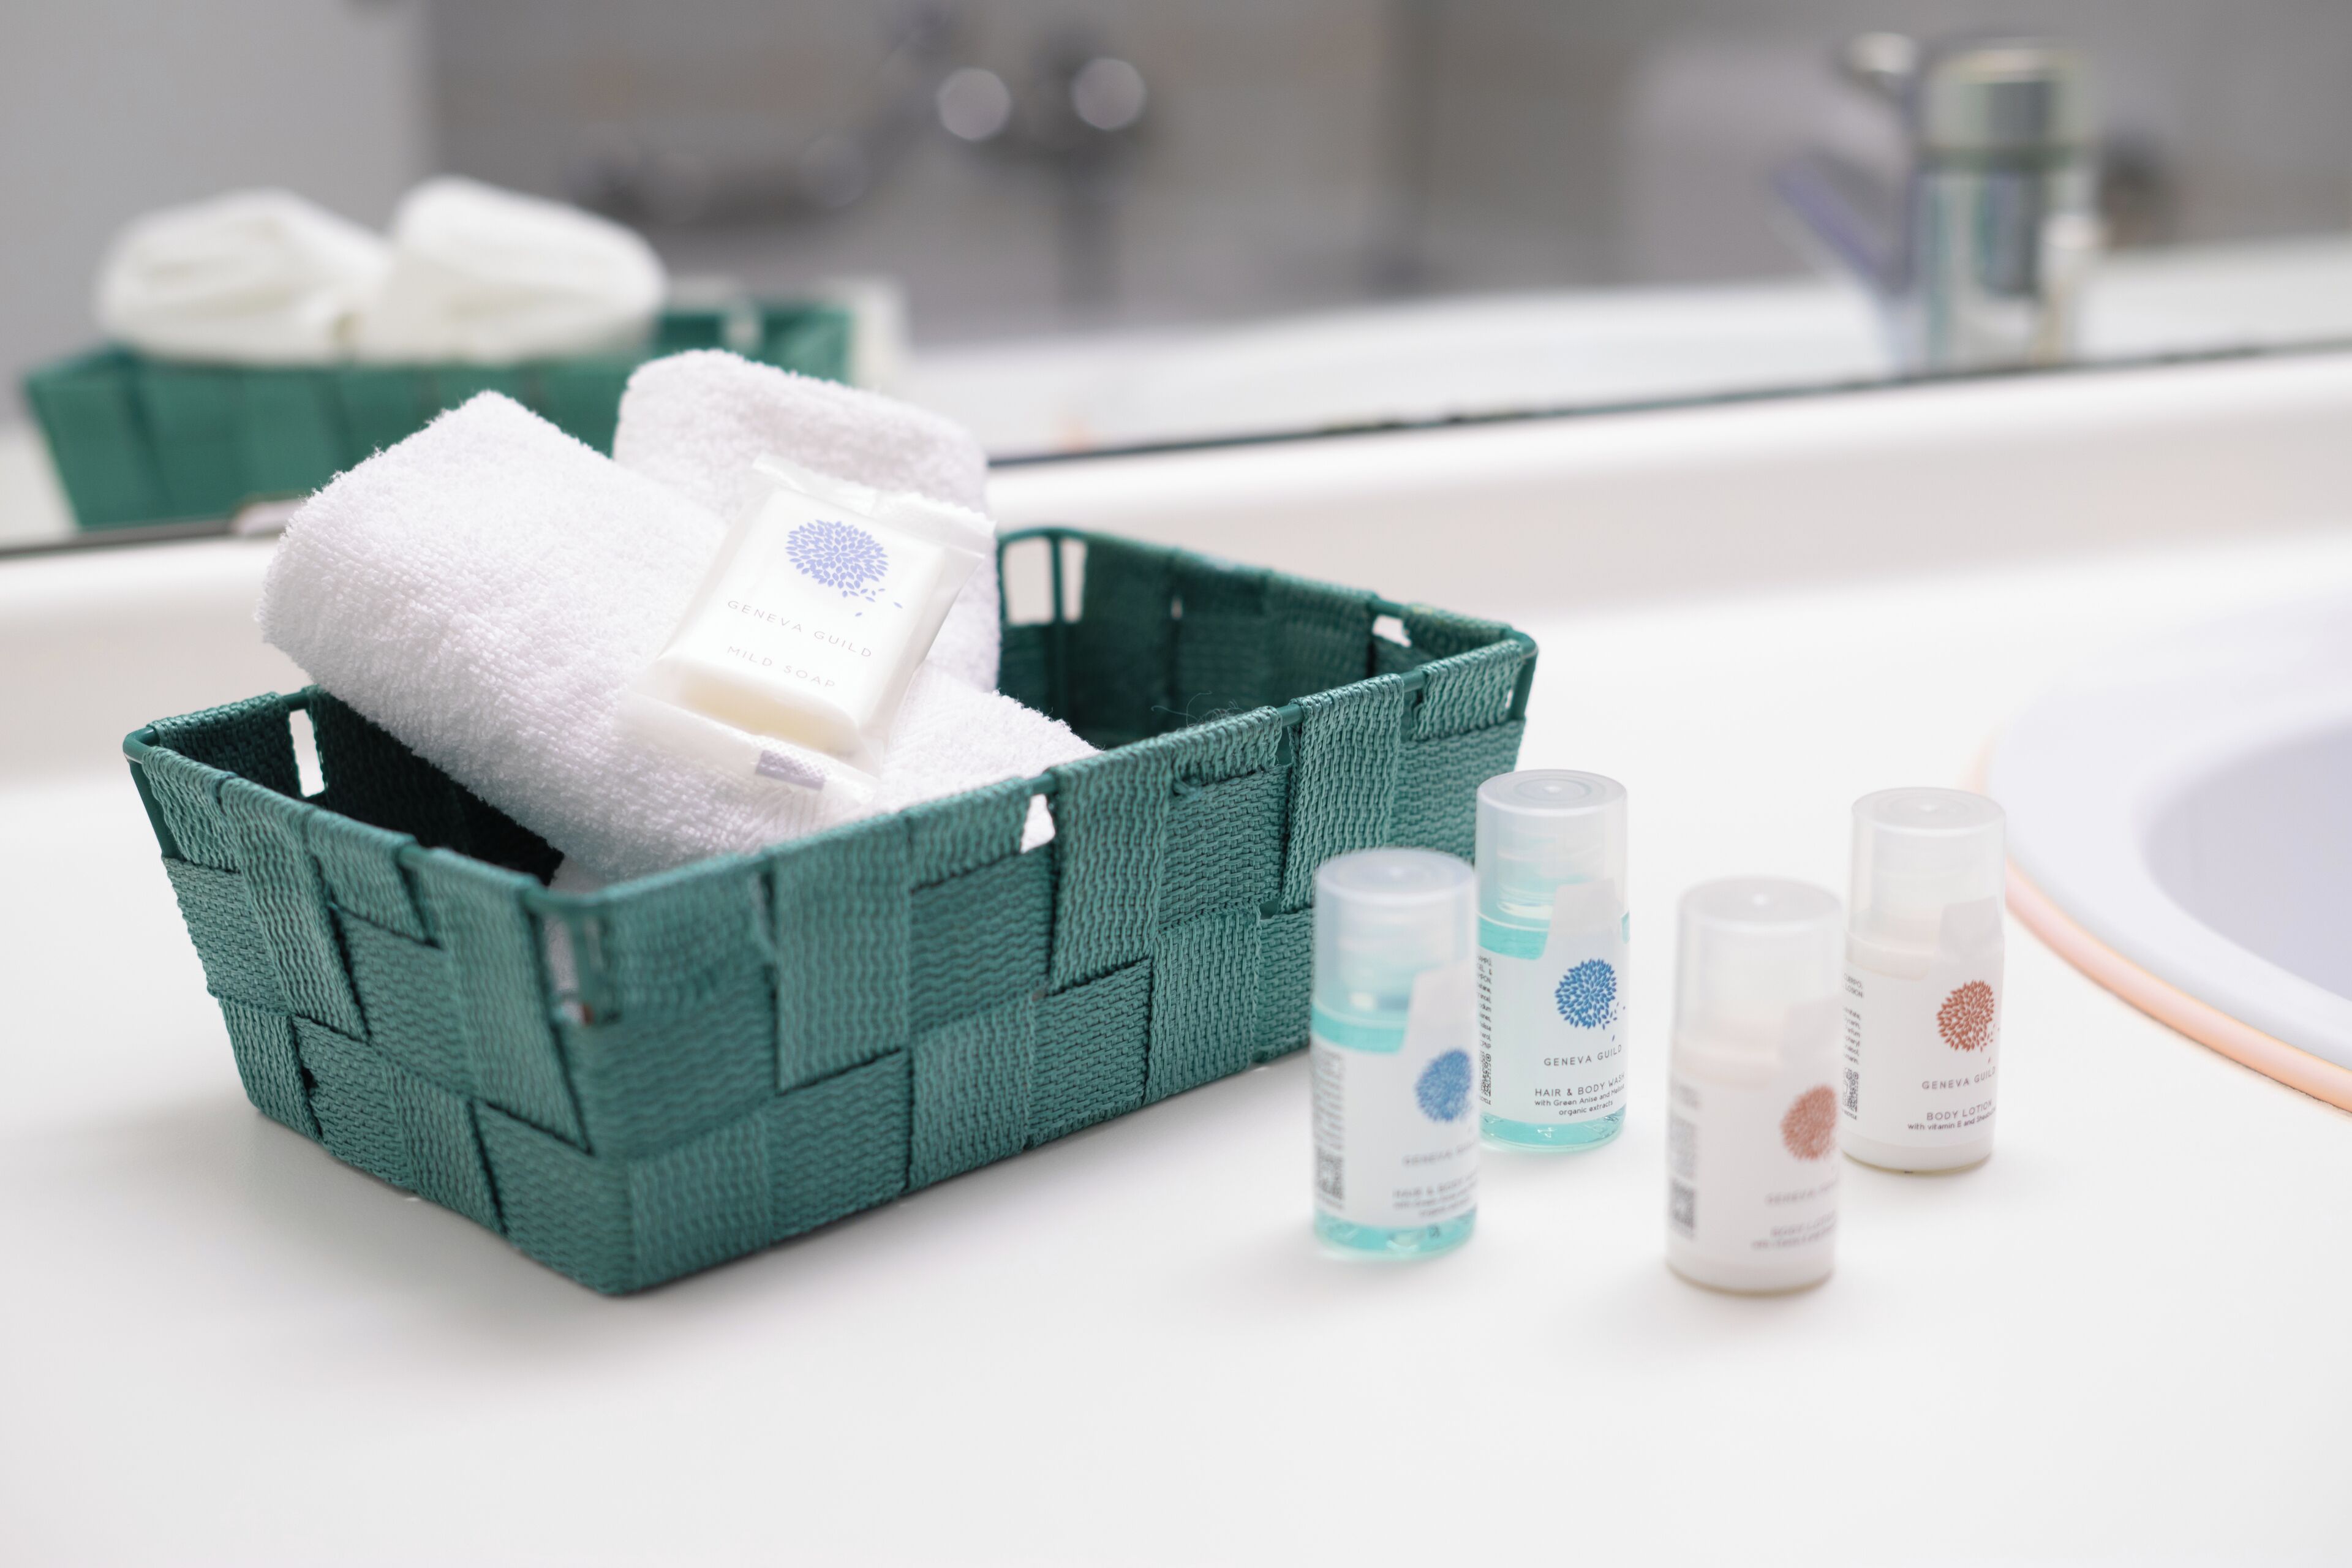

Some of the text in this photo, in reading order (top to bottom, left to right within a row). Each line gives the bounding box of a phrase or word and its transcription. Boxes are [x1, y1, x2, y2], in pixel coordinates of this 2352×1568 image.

[728, 600, 872, 657] GENEVA GUILD
[727, 646, 835, 687] MILD SOAP
[1544, 1044, 1622, 1066] GENEVA GUILD
[1534, 1072, 1625, 1097] HAIR & BODY WASH
[1921, 1066, 1996, 1089] GENEVA GUILD
[1599, 1091, 1610, 1100] and
[1558, 1101, 1613, 1116] organic extracts
[1926, 1099, 1992, 1120] BODY LOTION
[1964, 1118, 1975, 1126] and
